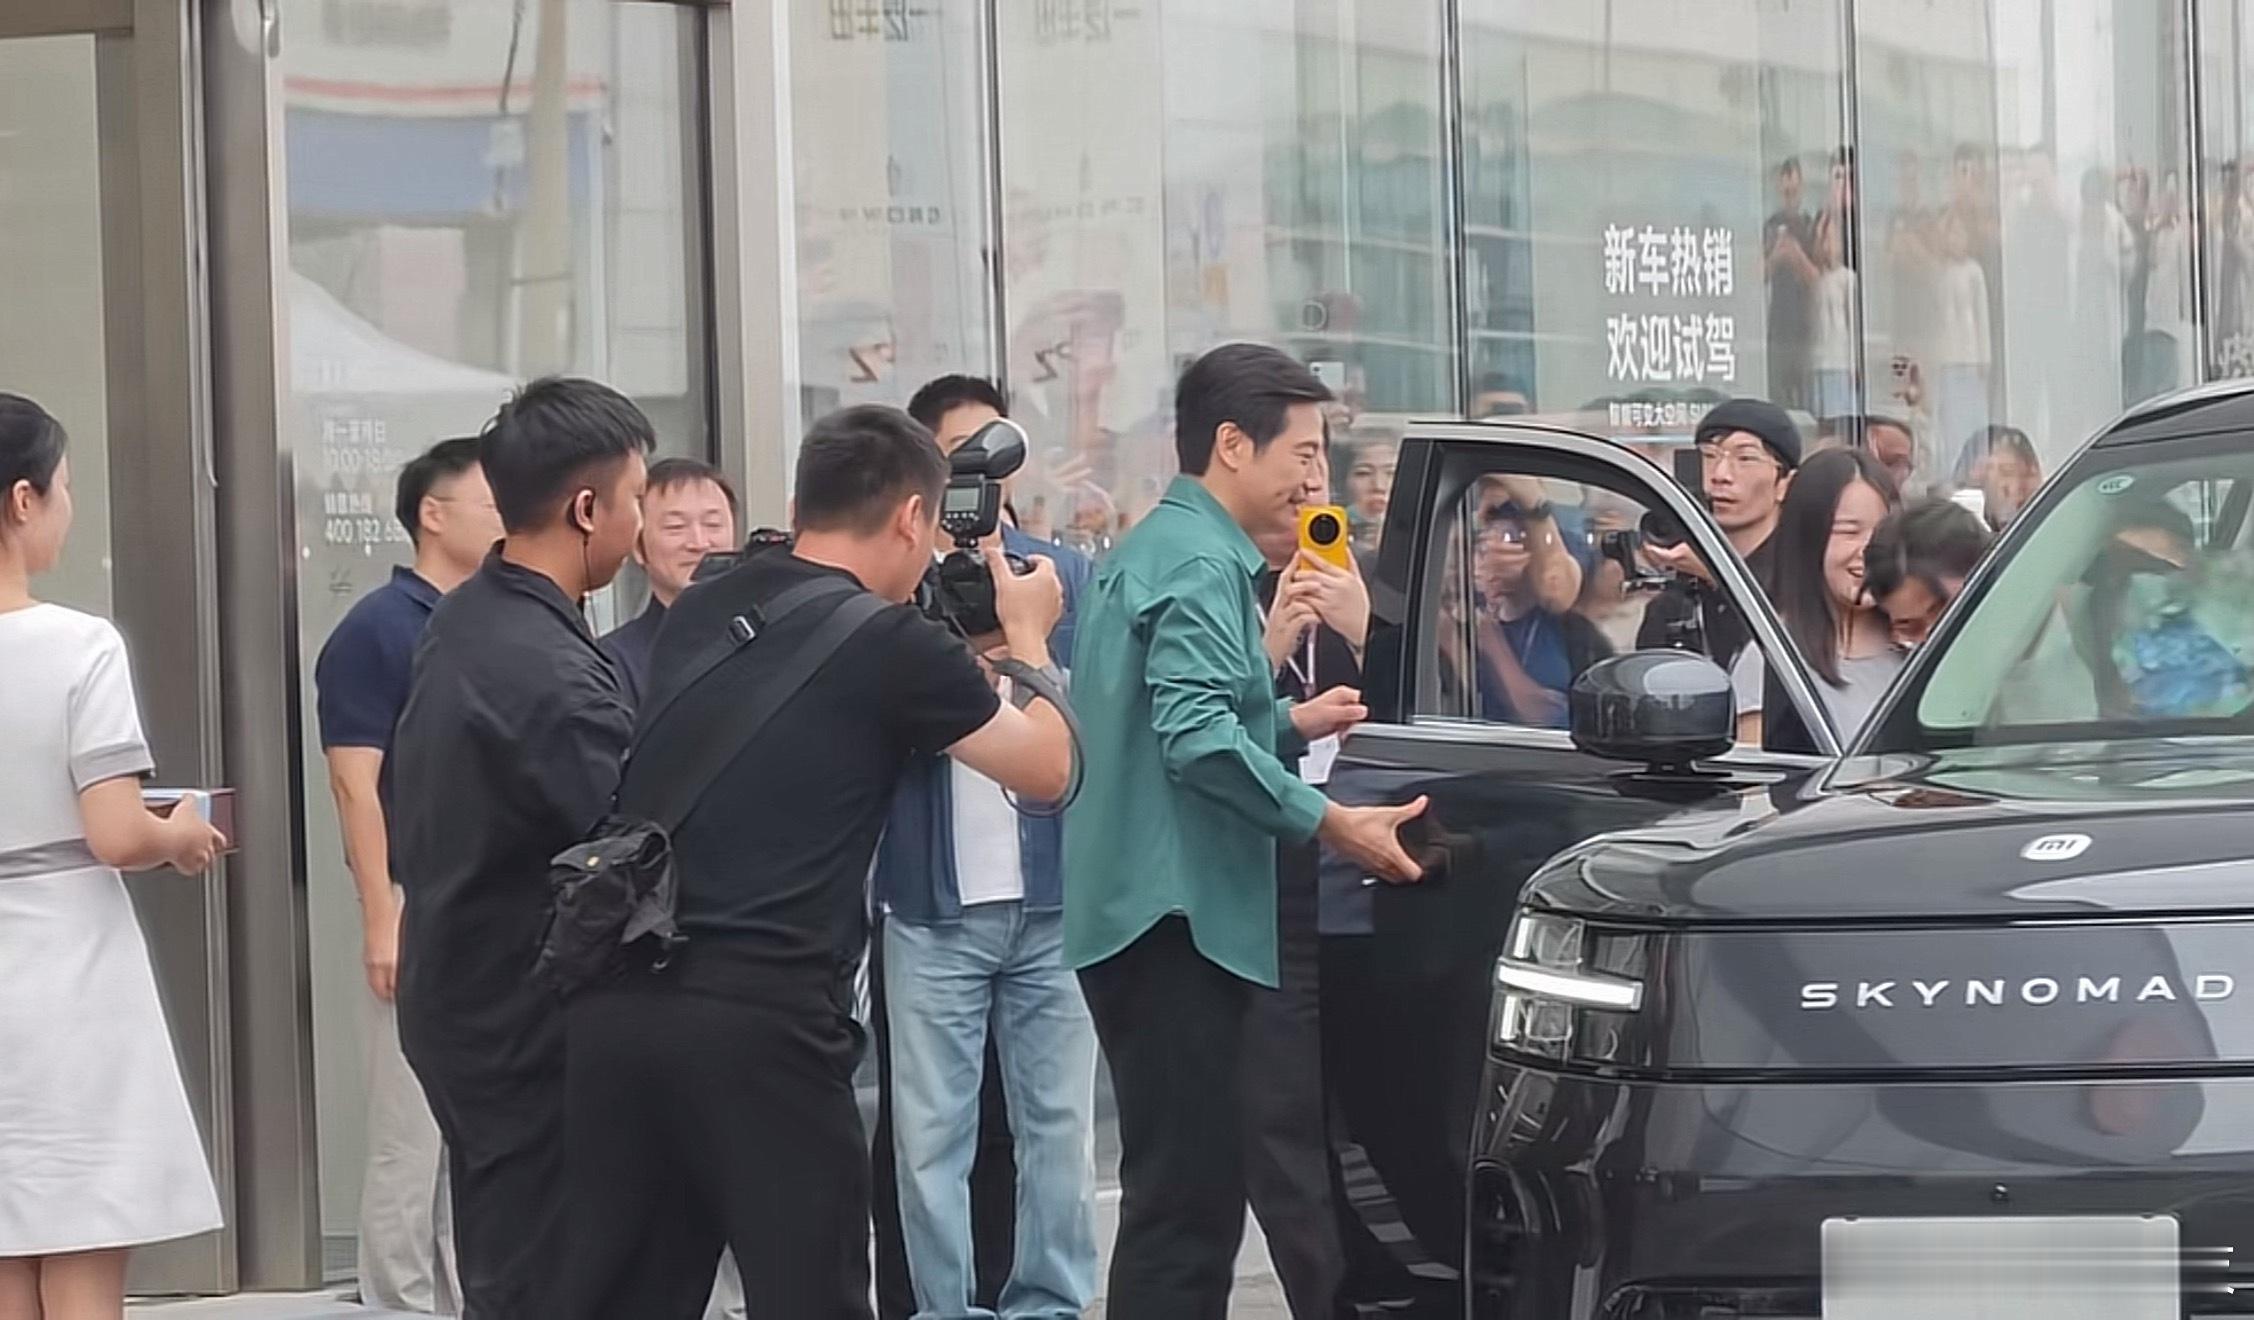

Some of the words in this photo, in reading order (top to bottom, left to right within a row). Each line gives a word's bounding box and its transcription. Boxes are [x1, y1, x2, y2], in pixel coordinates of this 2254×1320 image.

[1603, 223, 1734, 297] 新车热销
[1606, 312, 1736, 382] 欢迎试驾
[1800, 974, 2235, 1010] SKYNOMAD
